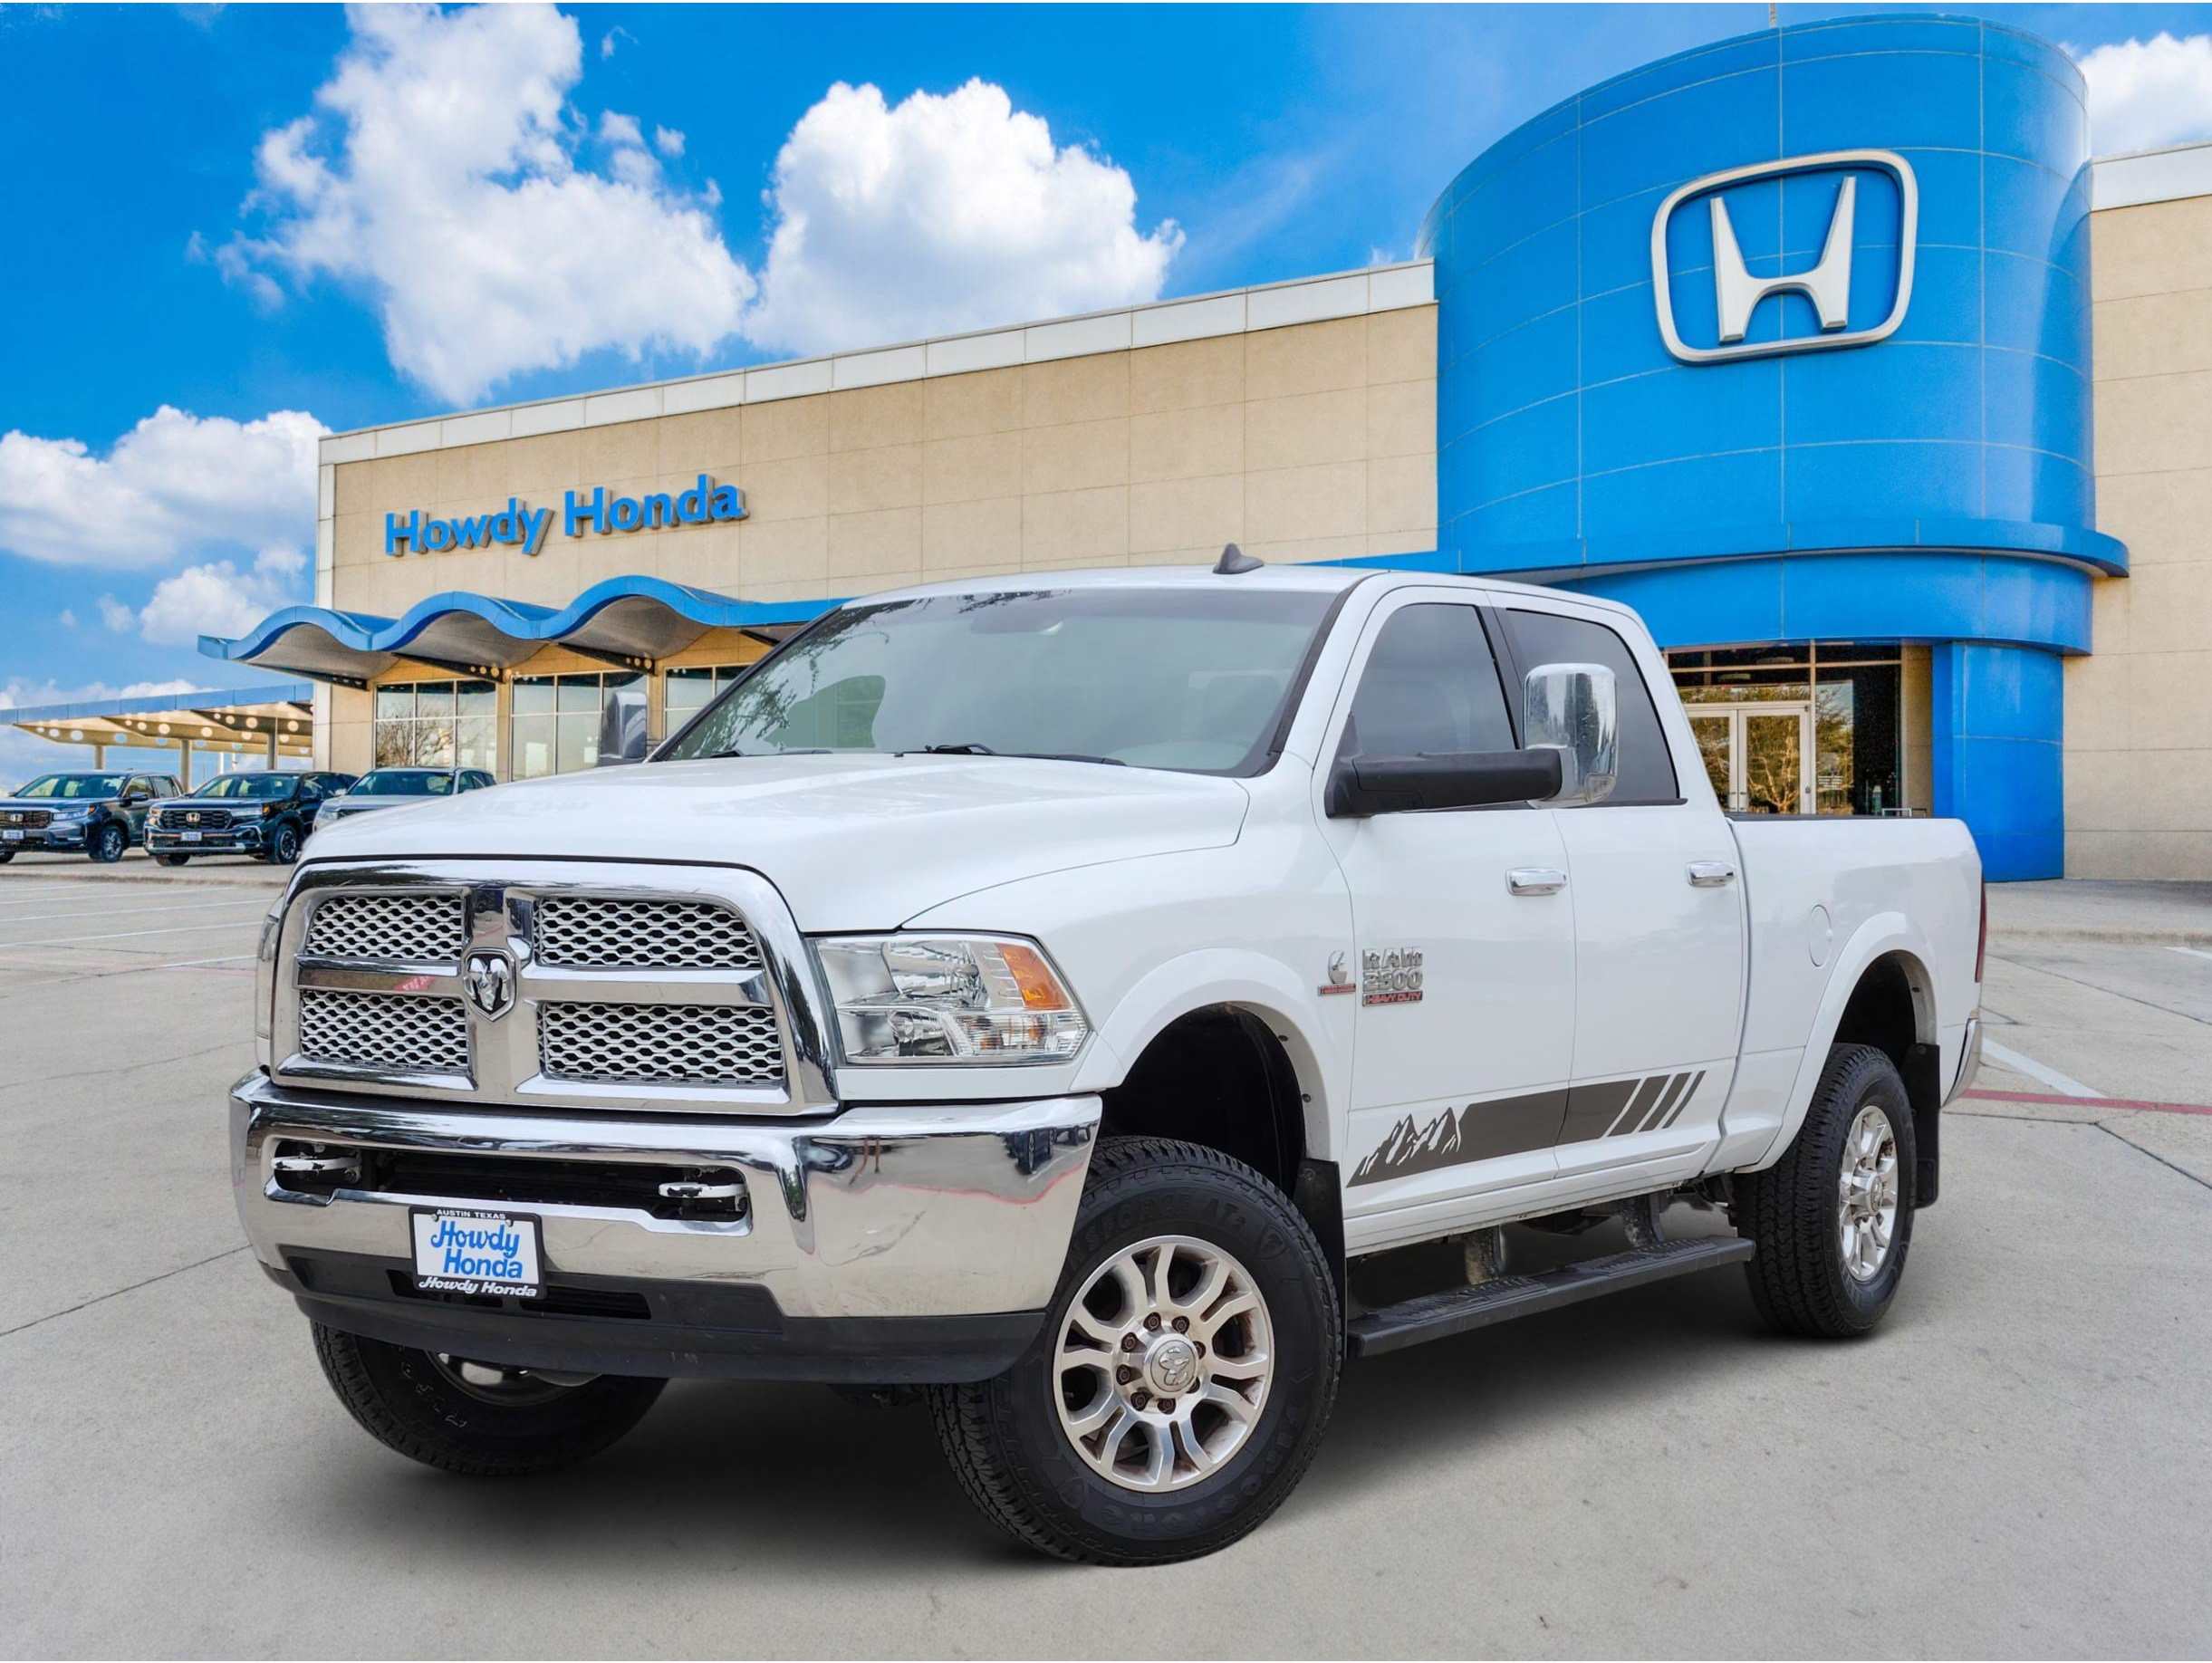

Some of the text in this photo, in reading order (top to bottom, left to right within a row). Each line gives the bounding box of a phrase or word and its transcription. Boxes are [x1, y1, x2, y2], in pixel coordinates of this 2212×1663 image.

[385, 474, 749, 556] Howdy Honda
[437, 1209, 506, 1220] AUSTIN TEXAS
[430, 1220, 520, 1258] Howdy
[443, 1248, 523, 1279] Honda
[418, 1276, 537, 1297] Howdy Honda
